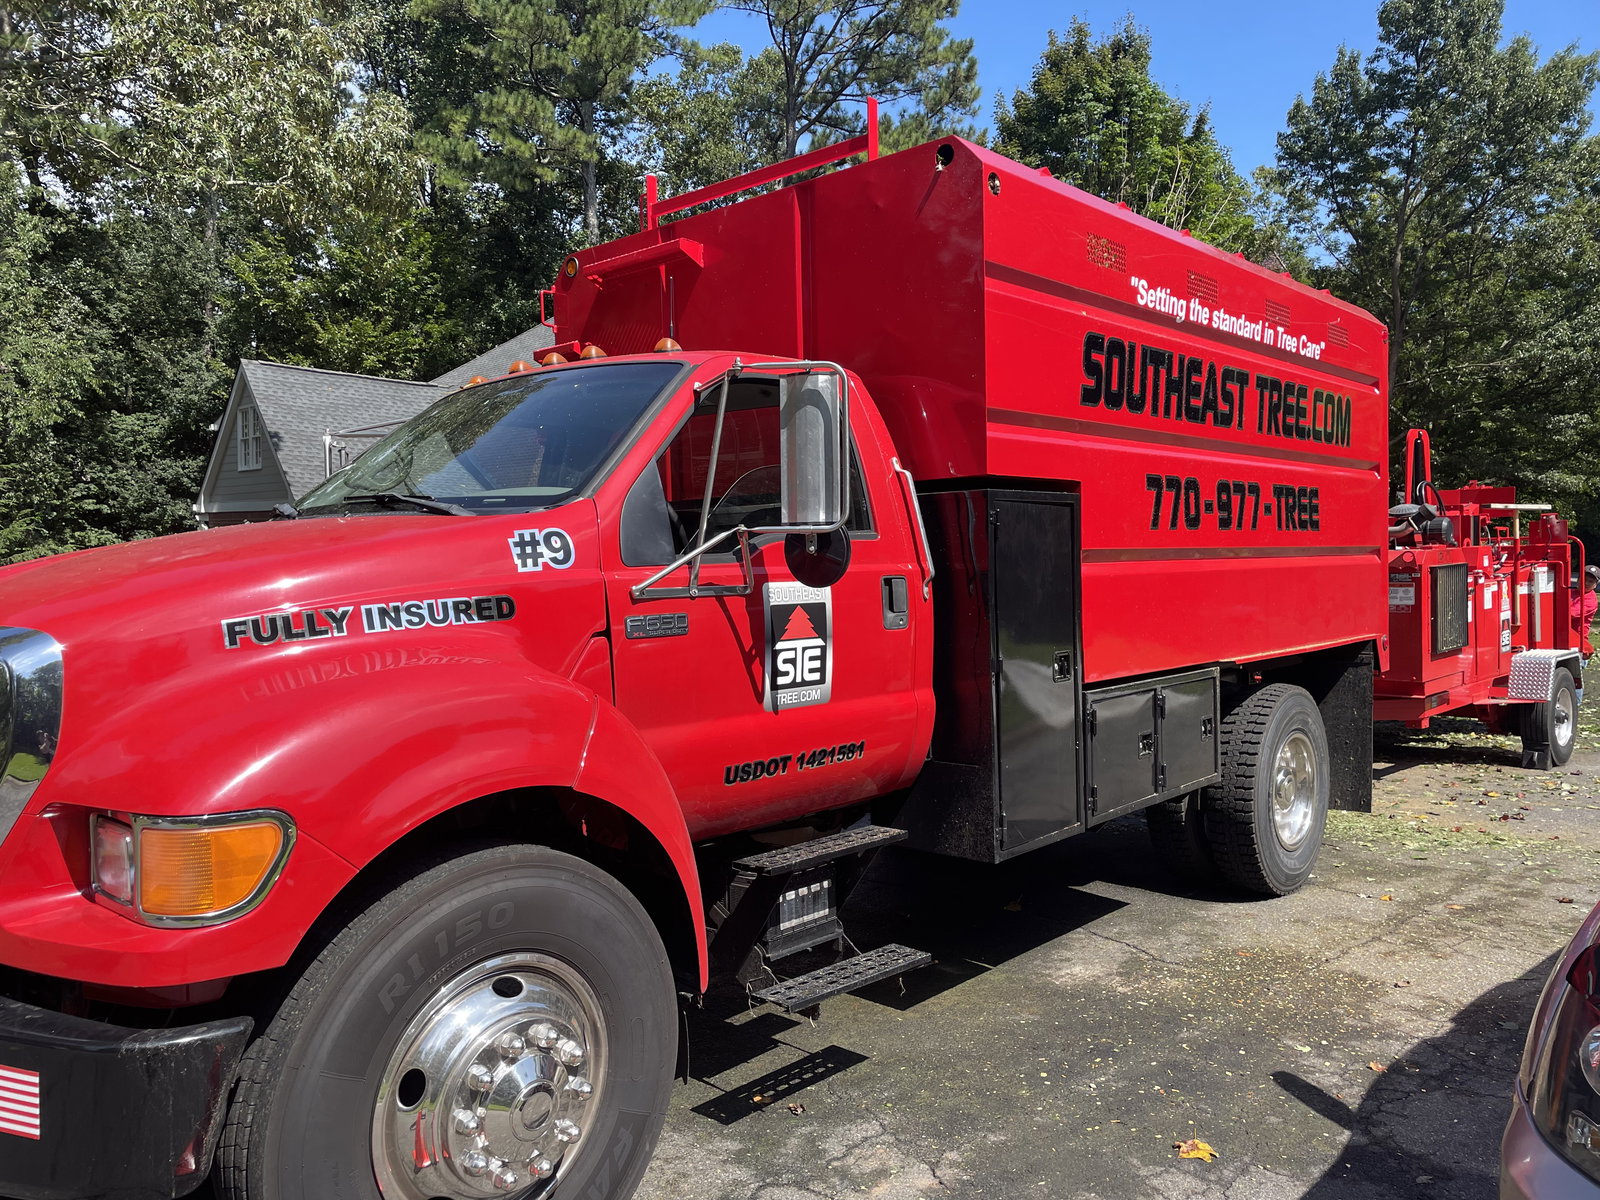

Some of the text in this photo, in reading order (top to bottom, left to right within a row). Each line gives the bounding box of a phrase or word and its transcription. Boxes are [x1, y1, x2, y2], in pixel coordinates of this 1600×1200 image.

[1130, 275, 1326, 360] "Setting the standard in Tree Care"
[1080, 331, 1351, 448] SOUTHEAST TREE.COM
[1145, 473, 1320, 532] 770-977-TREE
[508, 528, 574, 572] #9
[768, 587, 827, 602] SOUTHEAST
[221, 595, 516, 649] FULLY INSURED
[773, 638, 826, 685] STE
[776, 689, 821, 705] TREE.COM
[724, 739, 866, 786] USDOT 1421581
